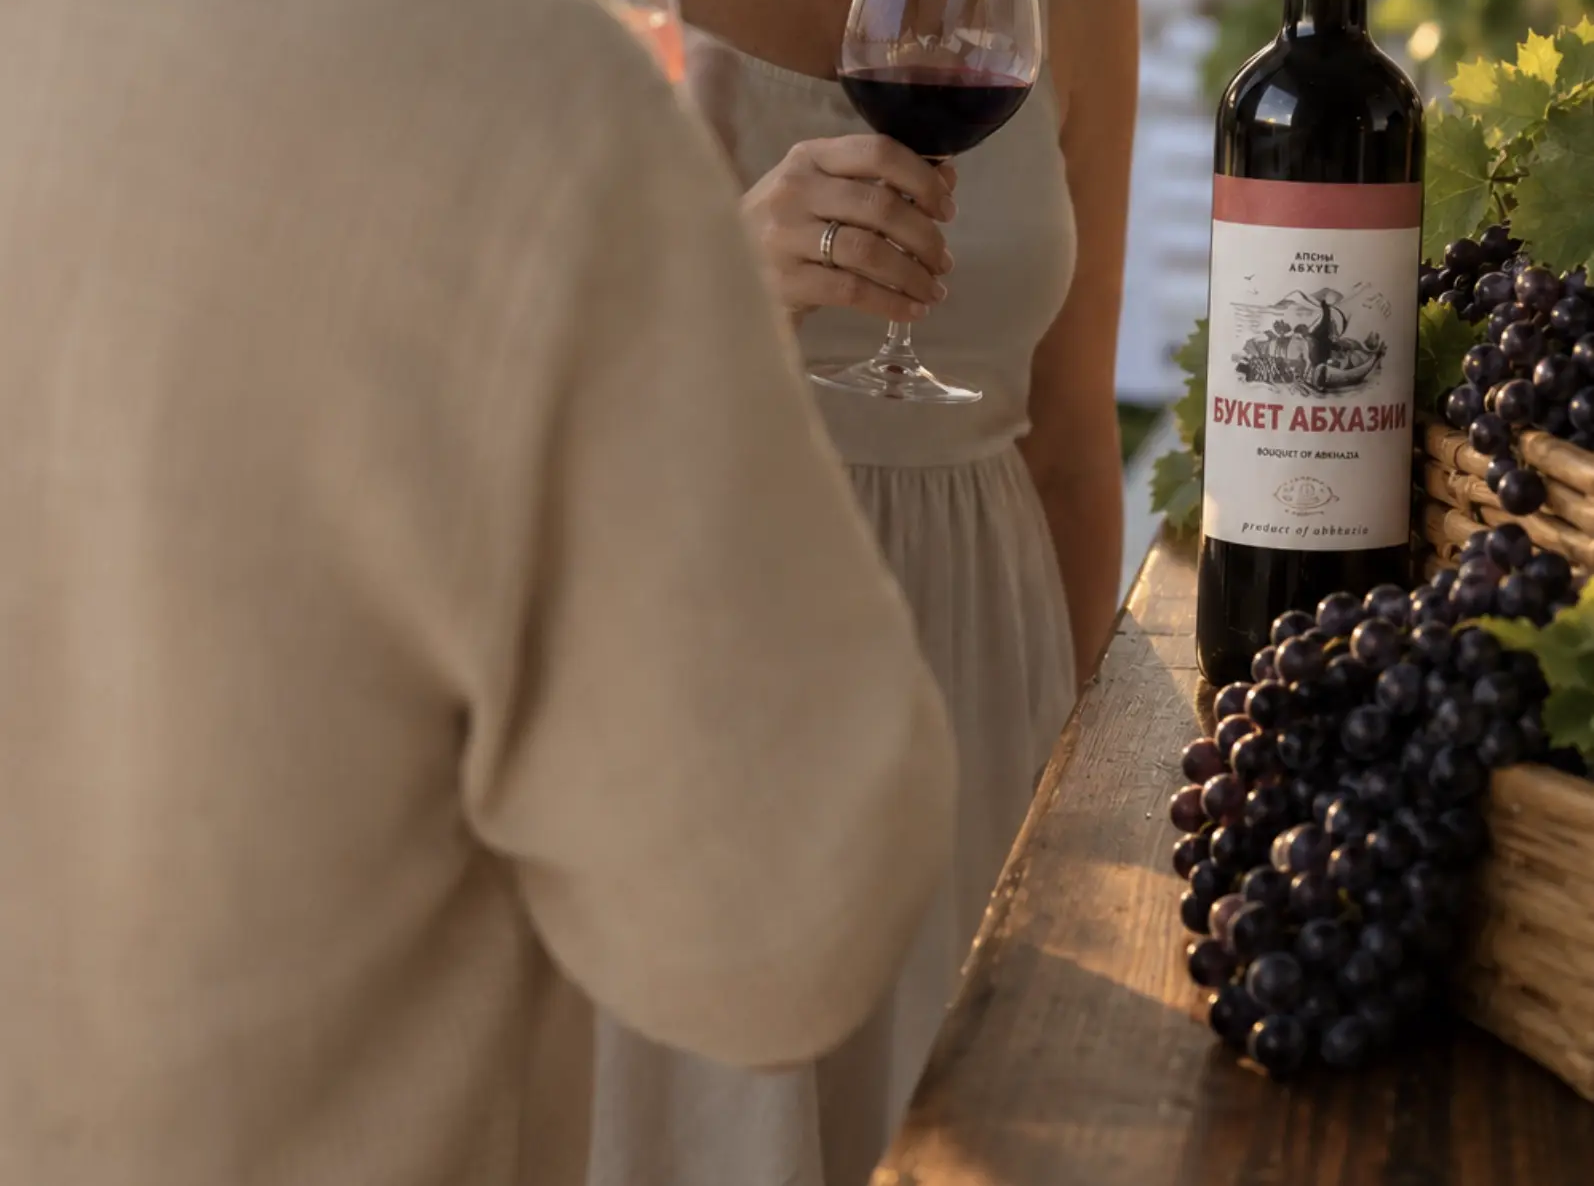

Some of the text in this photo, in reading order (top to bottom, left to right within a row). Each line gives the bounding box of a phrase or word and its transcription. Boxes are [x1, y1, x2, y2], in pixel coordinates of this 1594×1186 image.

[1213, 396, 1406, 433] БУКЕТ АБХАЗИИ
[1257, 447, 1298, 459] BOUQUET
[1300, 450, 1312, 459] OF
[1242, 522, 1290, 534] product
[1295, 525, 1309, 538] of
